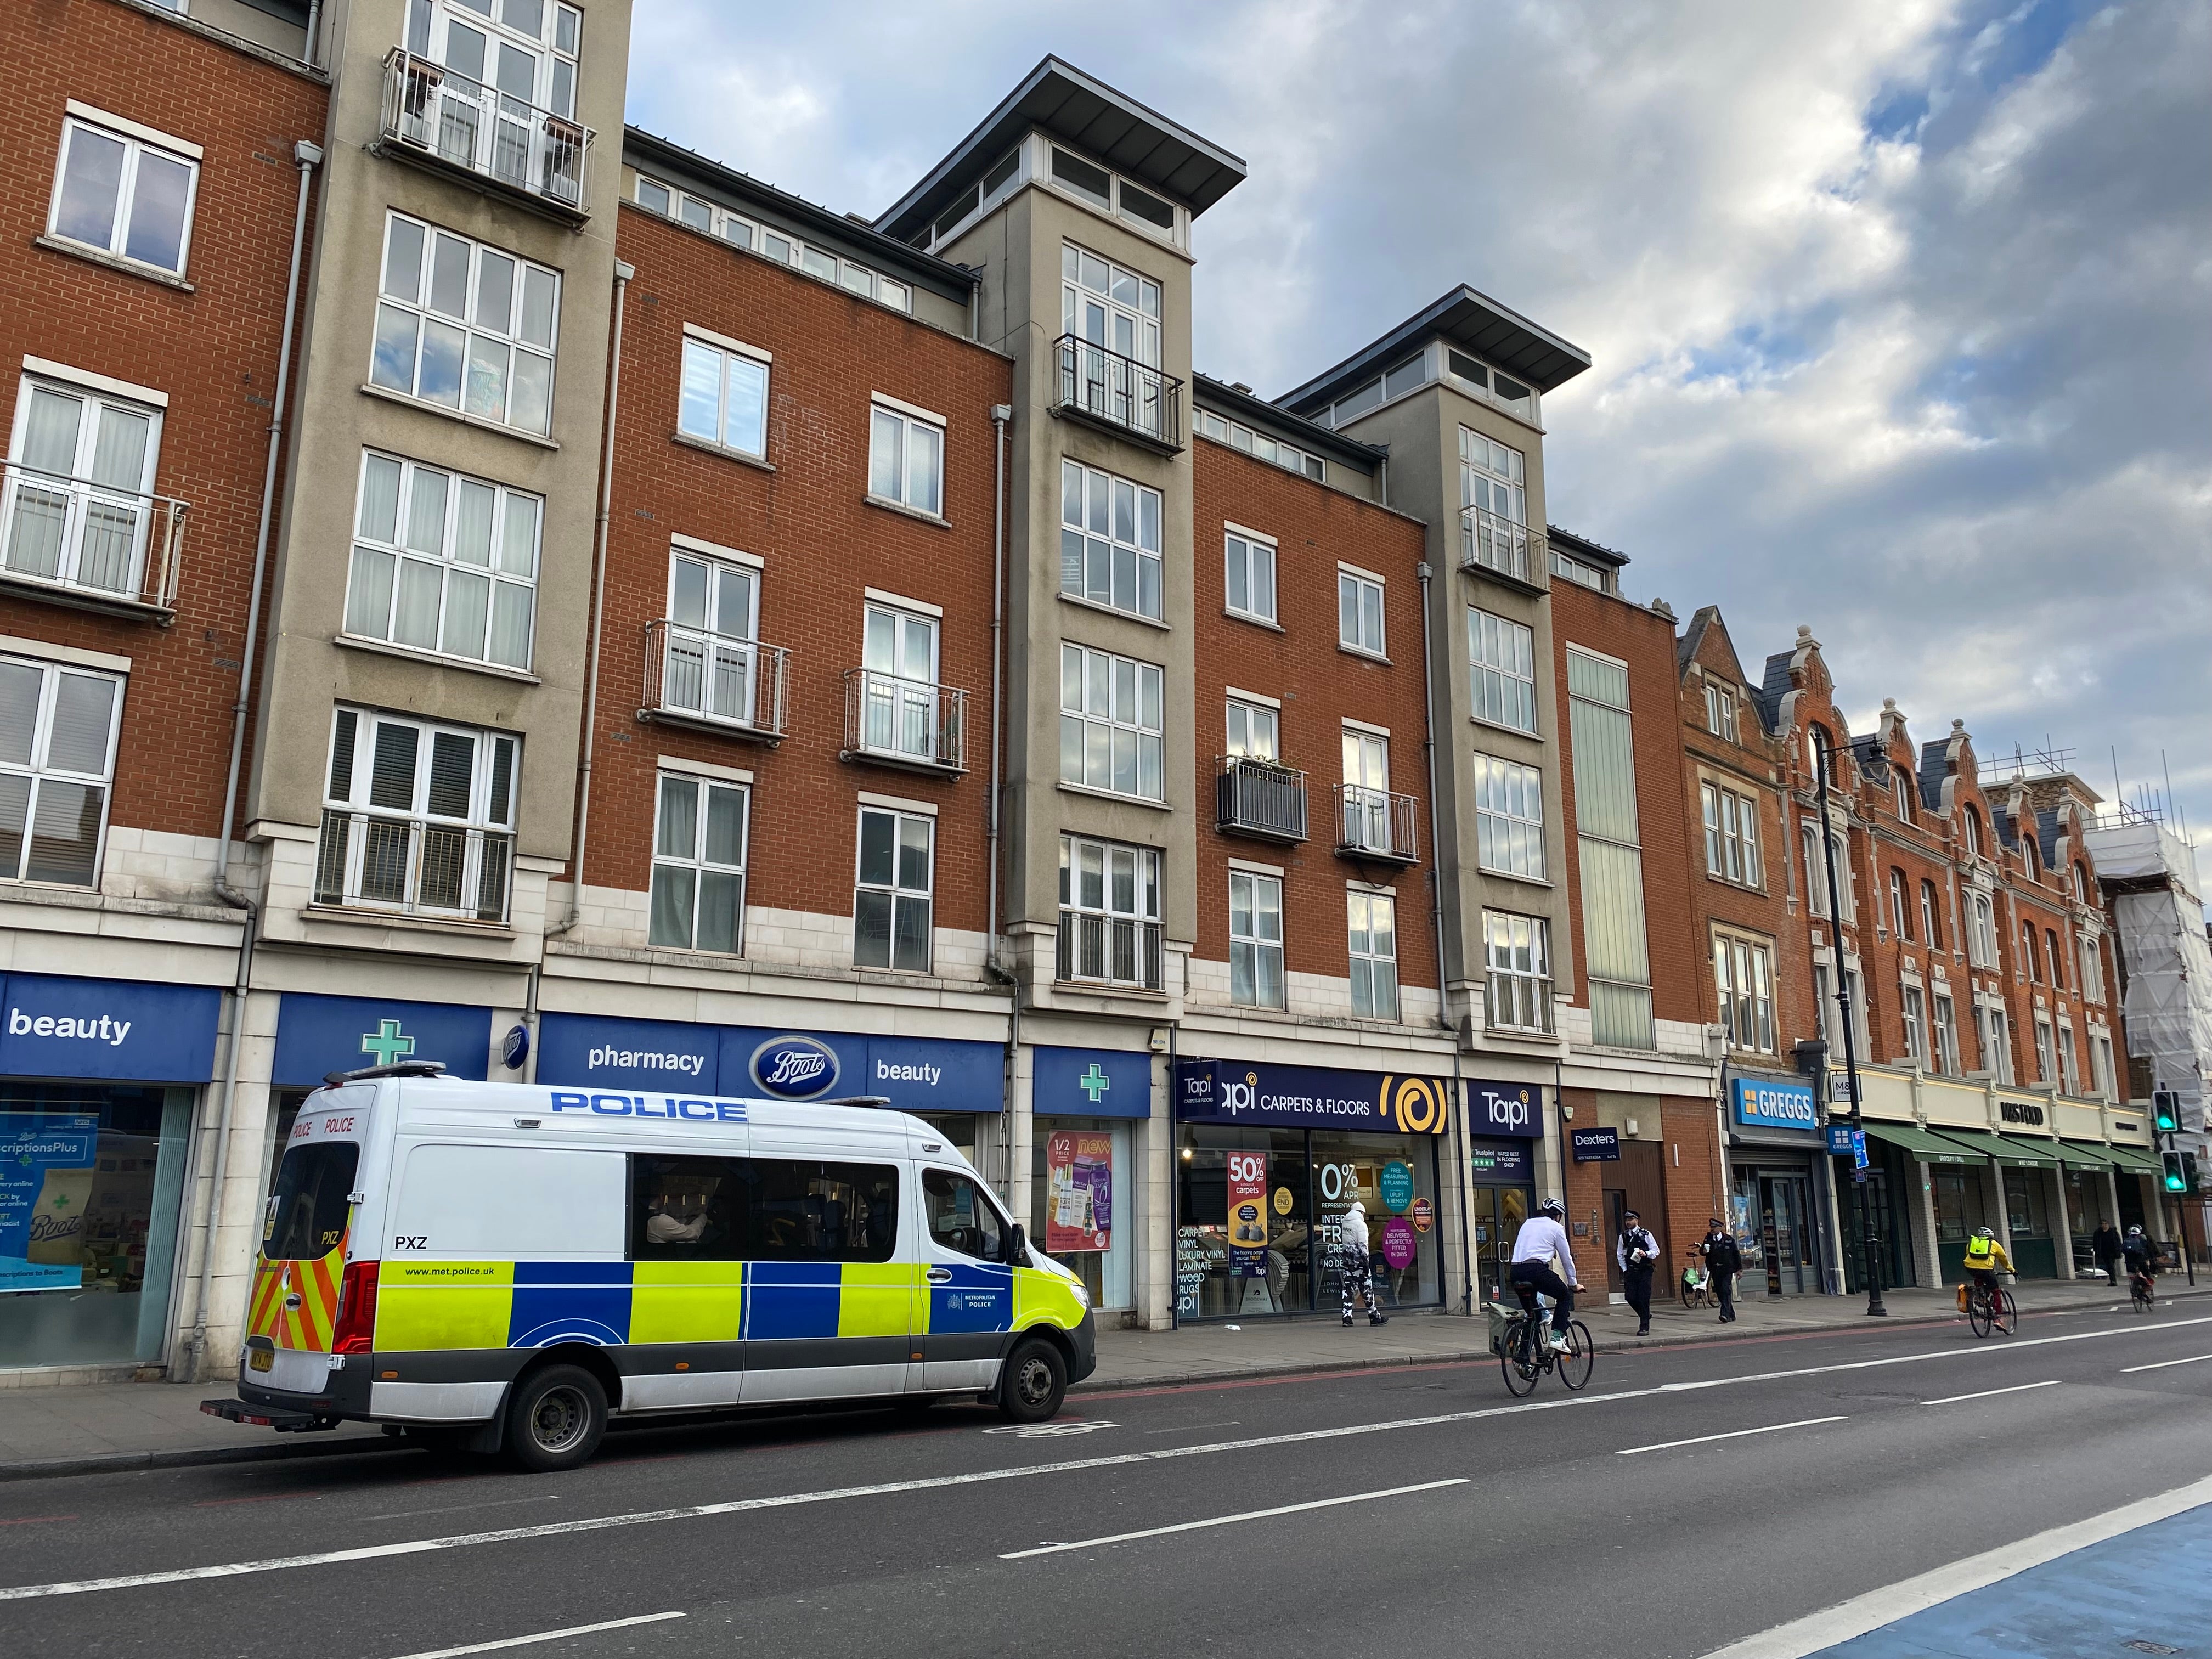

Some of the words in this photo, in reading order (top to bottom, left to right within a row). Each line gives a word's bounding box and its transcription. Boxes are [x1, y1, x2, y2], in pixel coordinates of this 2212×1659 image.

[9, 1008, 131, 1045] beauty
[589, 1045, 704, 1075] pharmacy
[767, 1051, 825, 1084] Boots
[878, 1060, 940, 1085] beauty
[1184, 1074, 1211, 1096] Tapi
[1836, 1081, 1850, 1090] M&
[1222, 1071, 1257, 1115] api
[1261, 1095, 1313, 1113] CARPETS
[1316, 1099, 1324, 1113] &
[1326, 1099, 1370, 1116] FLOORS
[550, 1092, 748, 1121] POLICE
[1482, 1090, 1529, 1131] Tapi
[1759, 1090, 1812, 1121] GREGGS
[294, 1122, 312, 1138] POLICE
[324, 1118, 354, 1133] POLICE
[1054, 1139, 1070, 1150] 1/2
[1077, 1139, 1112, 1154] new
[1575, 1135, 1615, 1146] Dexters
[0, 1142, 77, 1155] criptionsPlus
[1230, 1156, 1264, 1182] 50%
[1321, 1164, 1358, 1200] 0%
[1236, 1187, 1259, 1195] carpets
[1344, 1190, 1359, 1199] APR
[321, 1231, 339, 1245] PXZ
[1178, 1228, 1206, 1237] CARPET
[1323, 1226, 1341, 1242] FR
[395, 1236, 427, 1249] PXZ
[1179, 1239, 1198, 1248] VINYL
[1328, 1244, 1343, 1253] CRE
[1179, 1250, 1205, 1260] LUXURY
[1207, 1250, 1226, 1259] VINYL
[405, 1268, 494, 1277] www.met.police.uk
[1179, 1262, 1212, 1271] LAMINATE
[1255, 1266, 1266, 1276] Tapi
[1180, 1273, 1205, 1283] WOOD
[1180, 1284, 1199, 1294] RUGS
